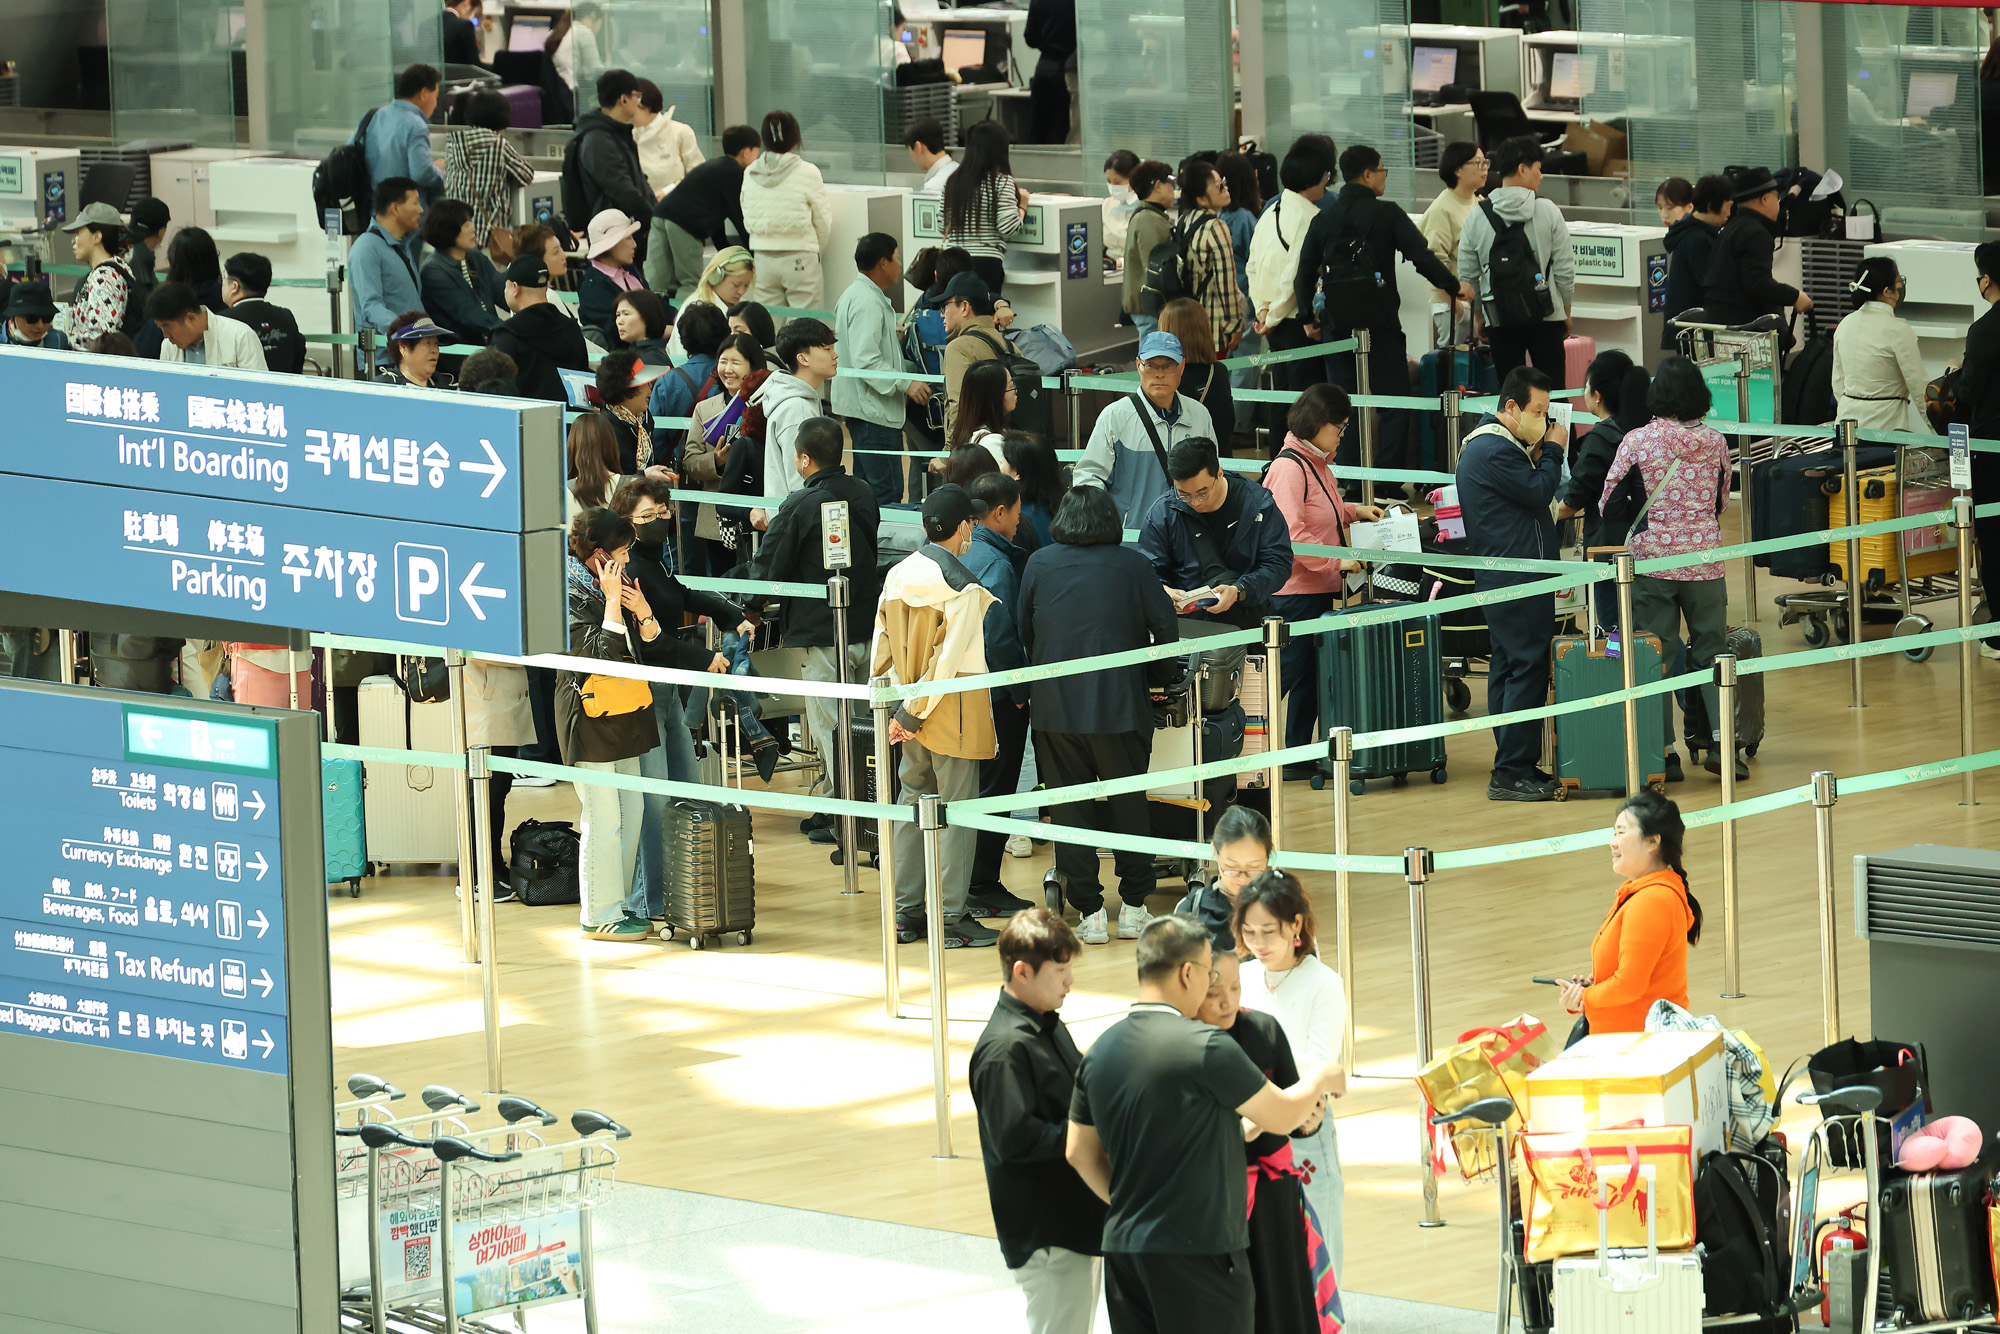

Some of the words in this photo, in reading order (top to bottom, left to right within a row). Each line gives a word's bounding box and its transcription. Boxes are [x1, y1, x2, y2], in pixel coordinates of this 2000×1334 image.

[1578, 258, 1602, 267] plastic
[1603, 259, 1616, 269] bag
[1580, 245, 1616, 257] 비닐팩에!
[65, 382, 160, 423] 国際線搭乗
[187, 395, 288, 439] 国际线登机
[174, 441, 289, 493] Boarding
[304, 428, 451, 489] 국제선탑승
[123, 510, 179, 548] 駐車場
[207, 519, 265, 558] 停车场
[1831, 532, 1849, 540] Incheon
[1850, 529, 1866, 537] Airport
[1362, 553, 1383, 561] Incheon
[1383, 554, 1402, 562] Airport
[1518, 563, 1537, 571] Airport
[1712, 551, 1730, 559] Incheon
[1731, 548, 1748, 557] Airport
[171, 559, 267, 613] Parking
[281, 542, 378, 602] 주차장
[408, 555, 440, 612] P
[1488, 594, 1506, 602] Incheon
[1506, 590, 1524, 599] Airport
[1361, 615, 1380, 623] Incheon
[1382, 612, 1398, 621] Airport
[1161, 647, 1181, 655] Incheon
[1182, 644, 1199, 652] Airport
[1868, 645, 1885, 653] Airport
[1024, 671, 1045, 679] Incheon
[1046, 666, 1064, 676] Airport
[1941, 765, 1958, 774] Airport
[119, 792, 156, 811] Toilets
[163, 783, 206, 811] 화장실
[1046, 830, 1068, 839] Incheon
[1070, 833, 1090, 842] Airport
[61, 843, 113, 870] Currency
[116, 849, 173, 874] Exchange
[179, 843, 208, 871] 환전
[43, 897, 104, 925] Beverages,
[109, 907, 138, 927] Food
[145, 896, 177, 927] 음료,
[181, 902, 209, 929] 식사
[115, 951, 146, 979] Tax
[150, 956, 215, 988] Refund
[15, 1008, 61, 1034] Baggage
[62, 1016, 110, 1039] Check-in
[119, 1010, 132, 1036] 큰
[137, 1013, 150, 1039] 짐
[155, 1016, 197, 1046] 부치는
[200, 1023, 215, 1048] 곳
[468, 1224, 507, 1251] 상하이
[475, 1233, 527, 1266] 여기어때
